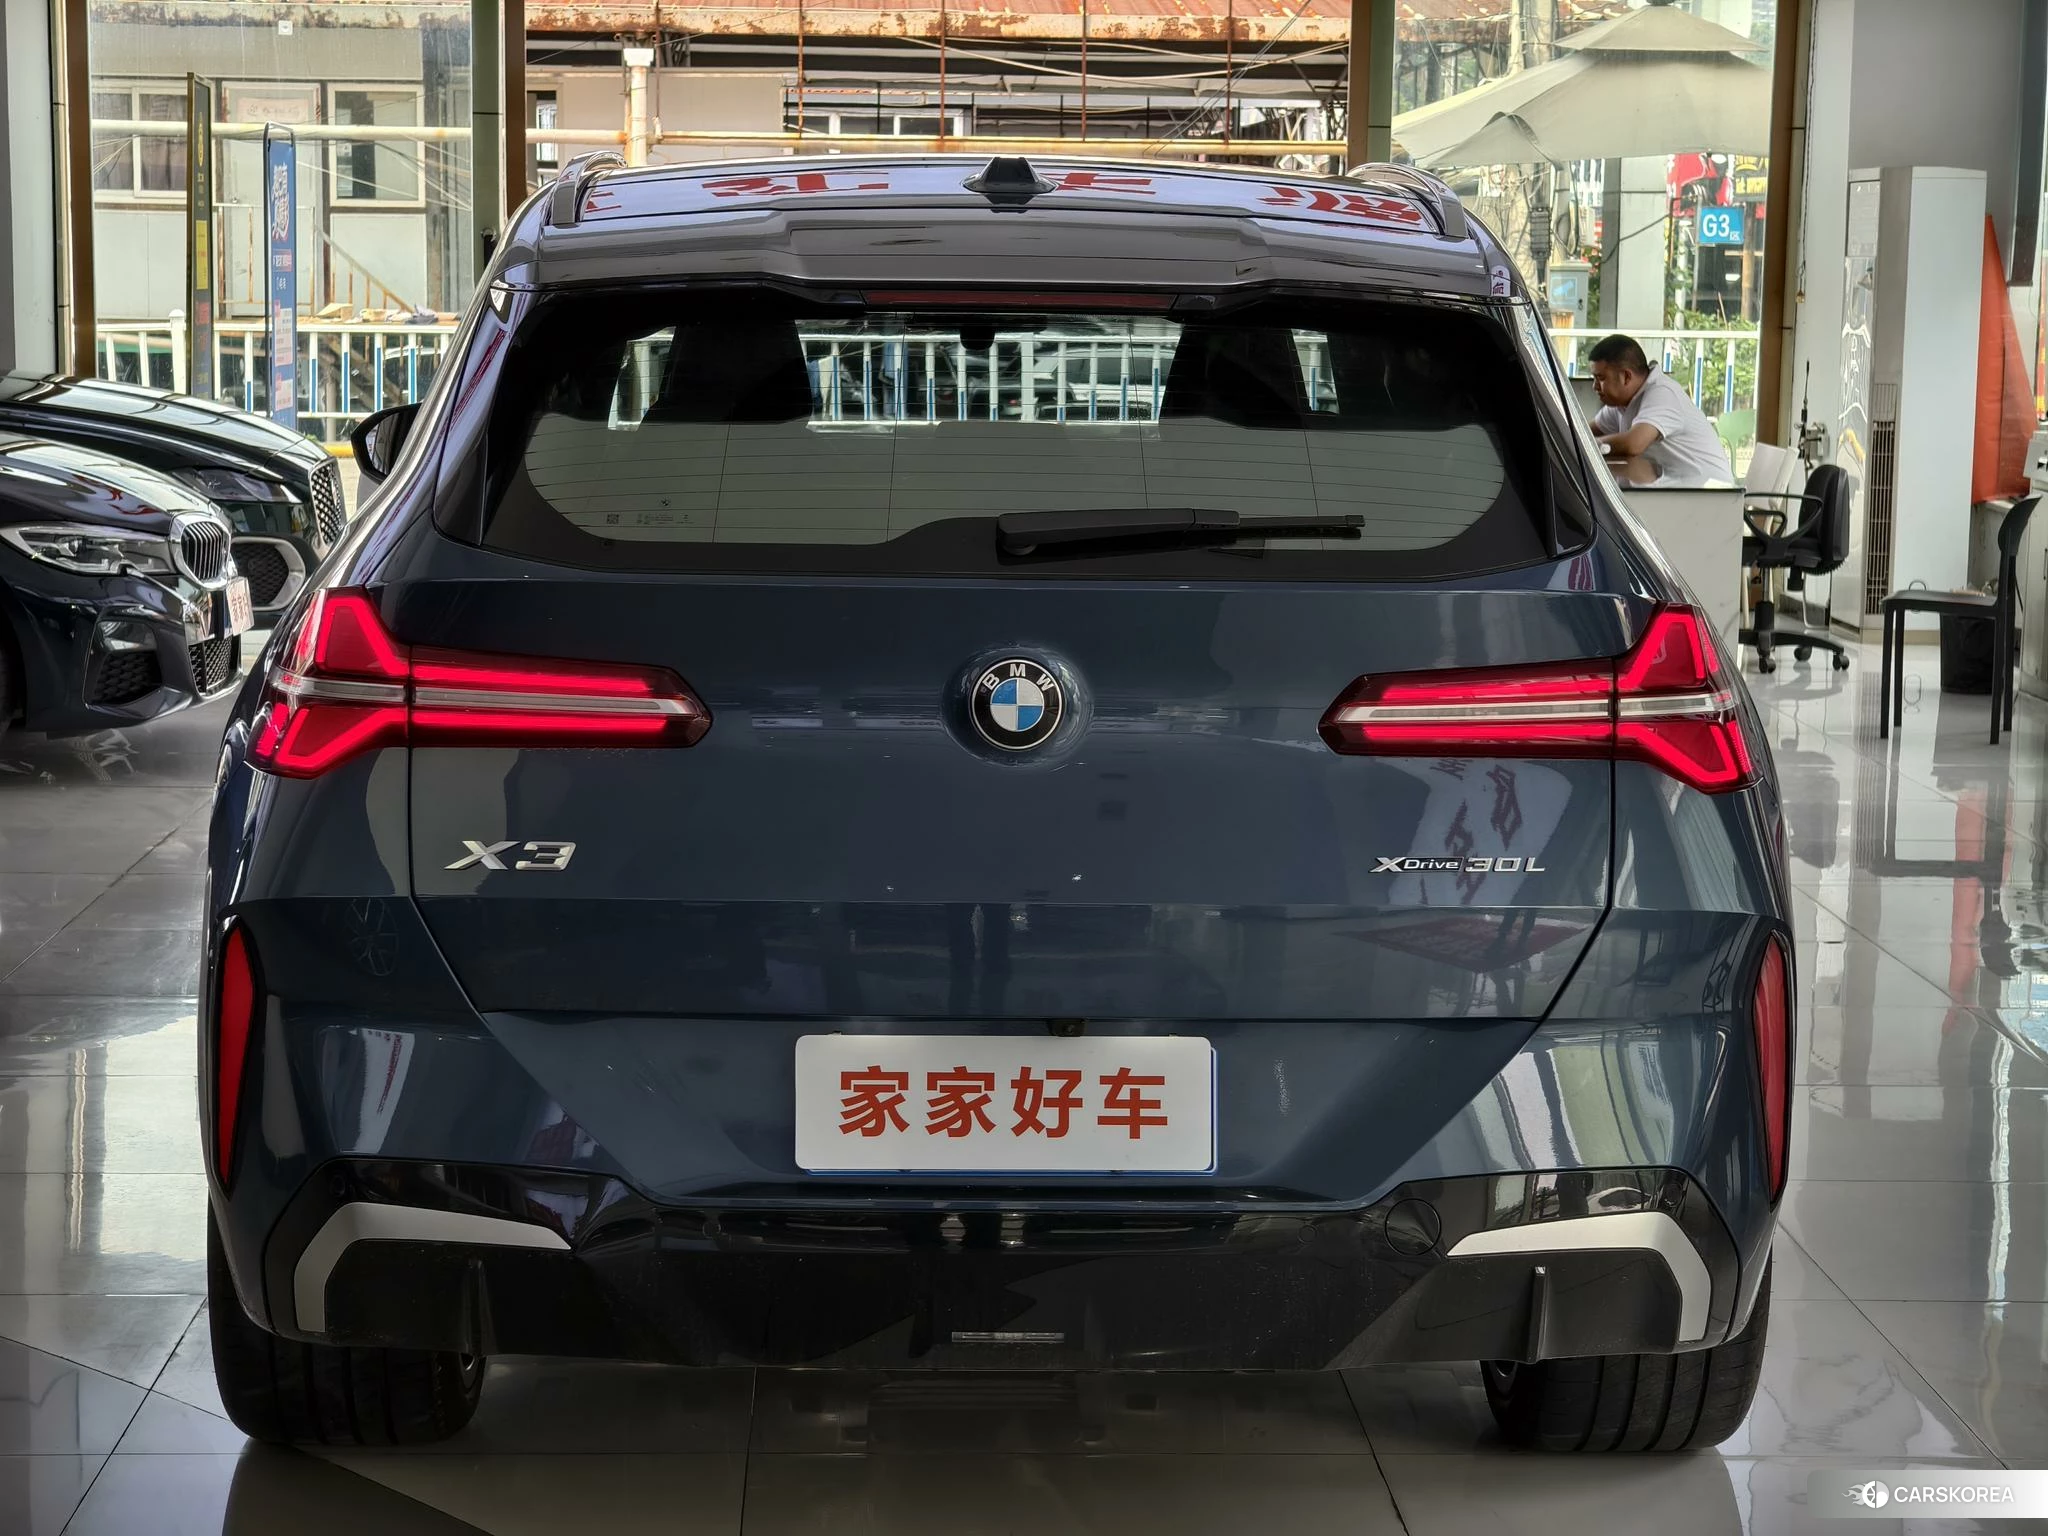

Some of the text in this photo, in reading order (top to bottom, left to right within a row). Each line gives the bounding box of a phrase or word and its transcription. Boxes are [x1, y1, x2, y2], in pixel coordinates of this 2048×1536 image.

[982, 664, 1054, 691] BMW
[444, 840, 577, 870] X3
[1466, 857, 1546, 872] 30L
[838, 1065, 1168, 1139] 家家好车
